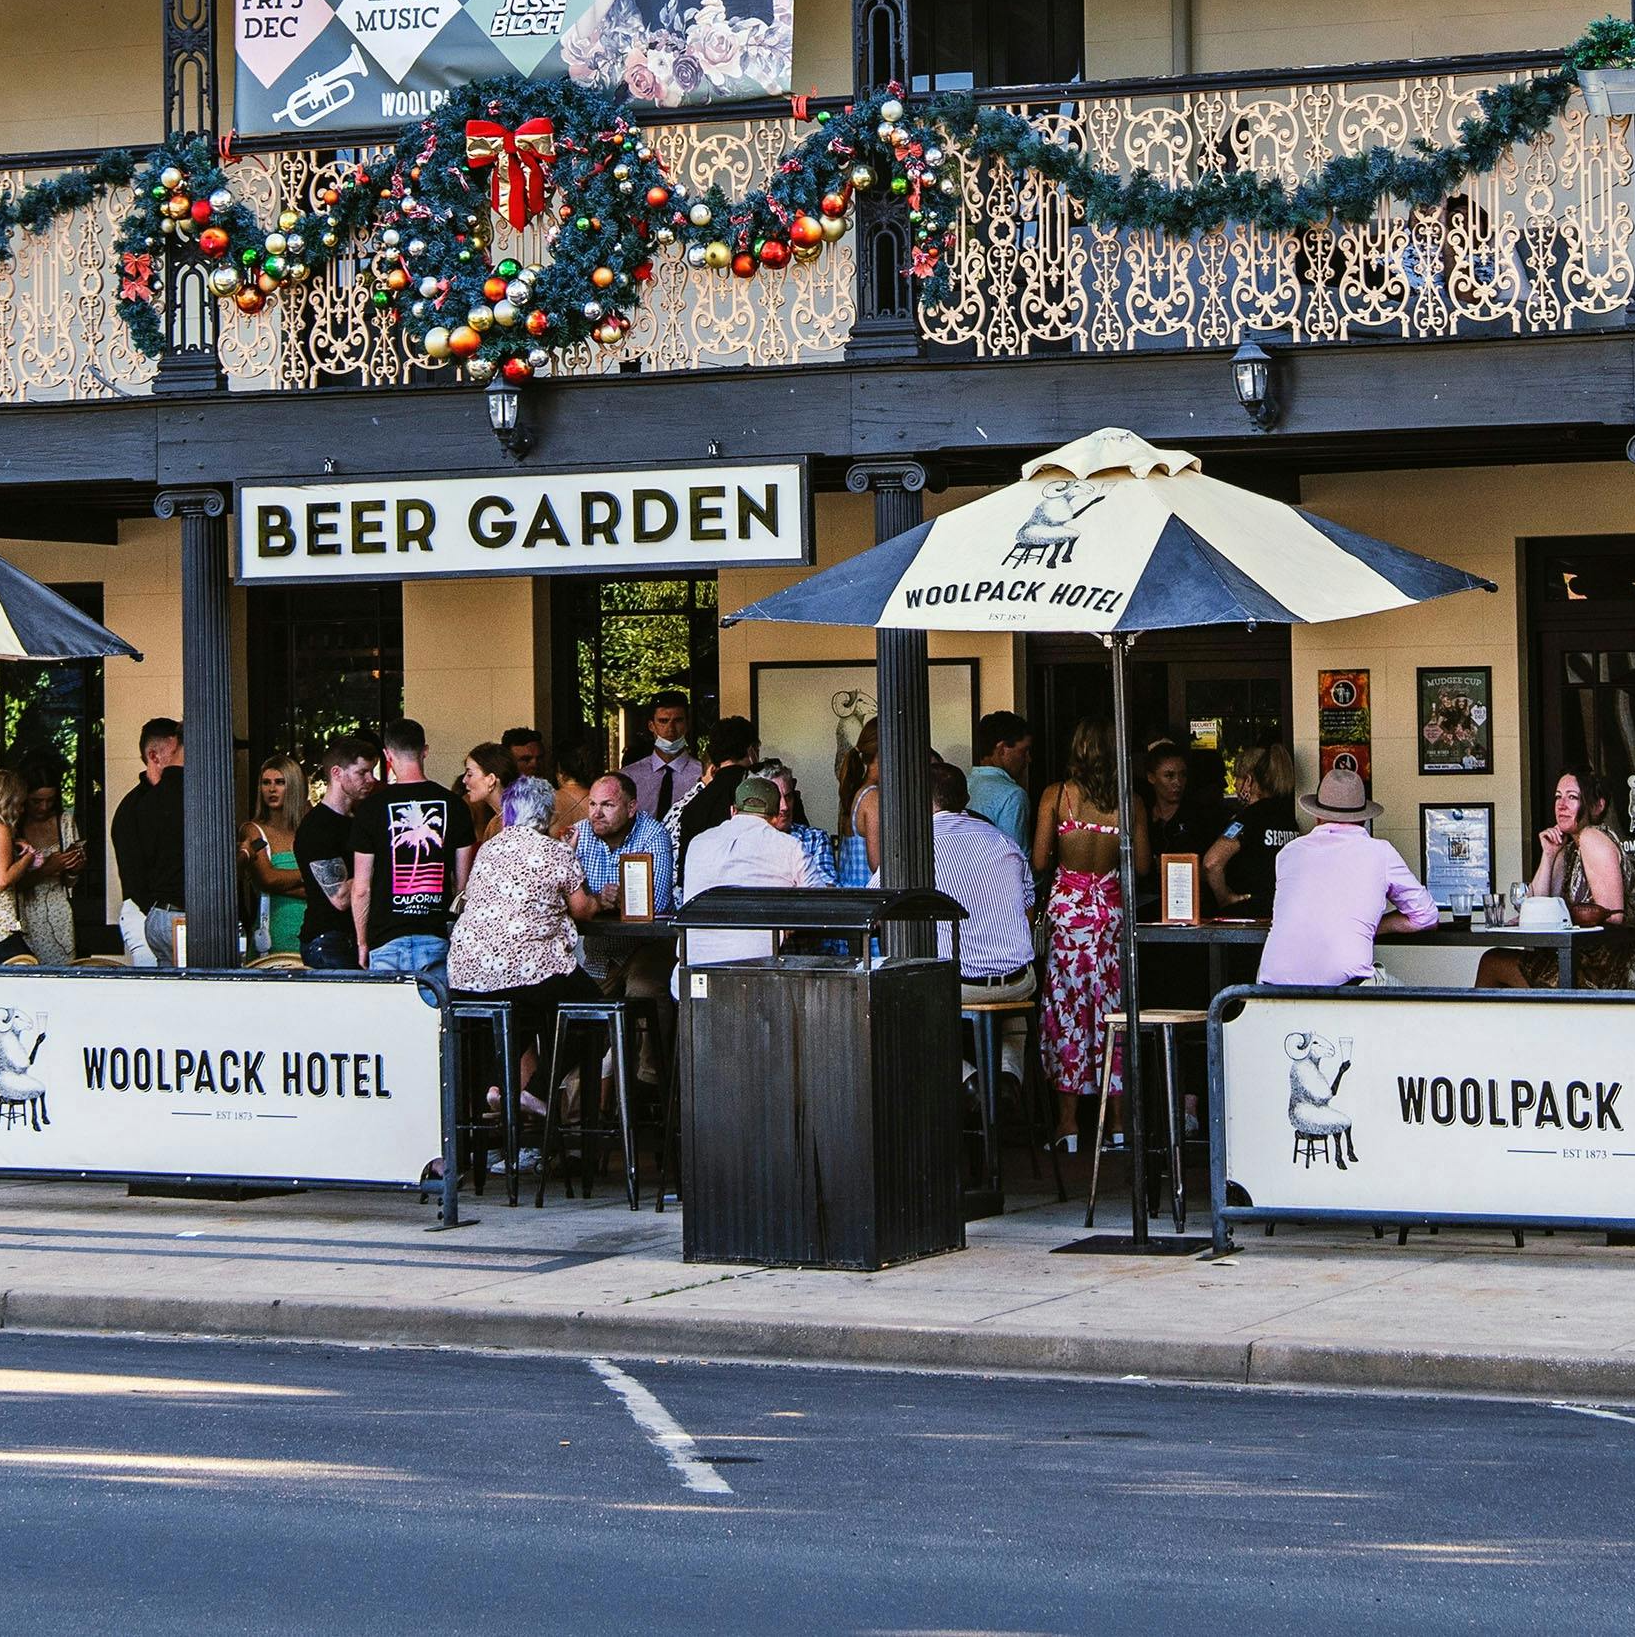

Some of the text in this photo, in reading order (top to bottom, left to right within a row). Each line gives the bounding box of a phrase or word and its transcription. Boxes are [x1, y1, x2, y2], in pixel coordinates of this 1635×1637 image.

[244, 15, 298, 39] DEC
[356, 6, 439, 33] MUSIC
[490, 7, 567, 38] BLOCH
[381, 90, 451, 117] WOOLP
[257, 483, 779, 558] BEER GARDEN
[906, 580, 1123, 613] WOOLPACK HOTEL
[1426, 677, 1482, 686] MUDGEE CUP
[393, 894, 442, 905] CALIFORNIA
[83, 1047, 392, 1099] WOOLPACK HOTEL
[216, 1111, 252, 1121] EST 1873
[1397, 1076, 1624, 1132] WOOLPACK
[1563, 1148, 1608, 1159] EST 1873
